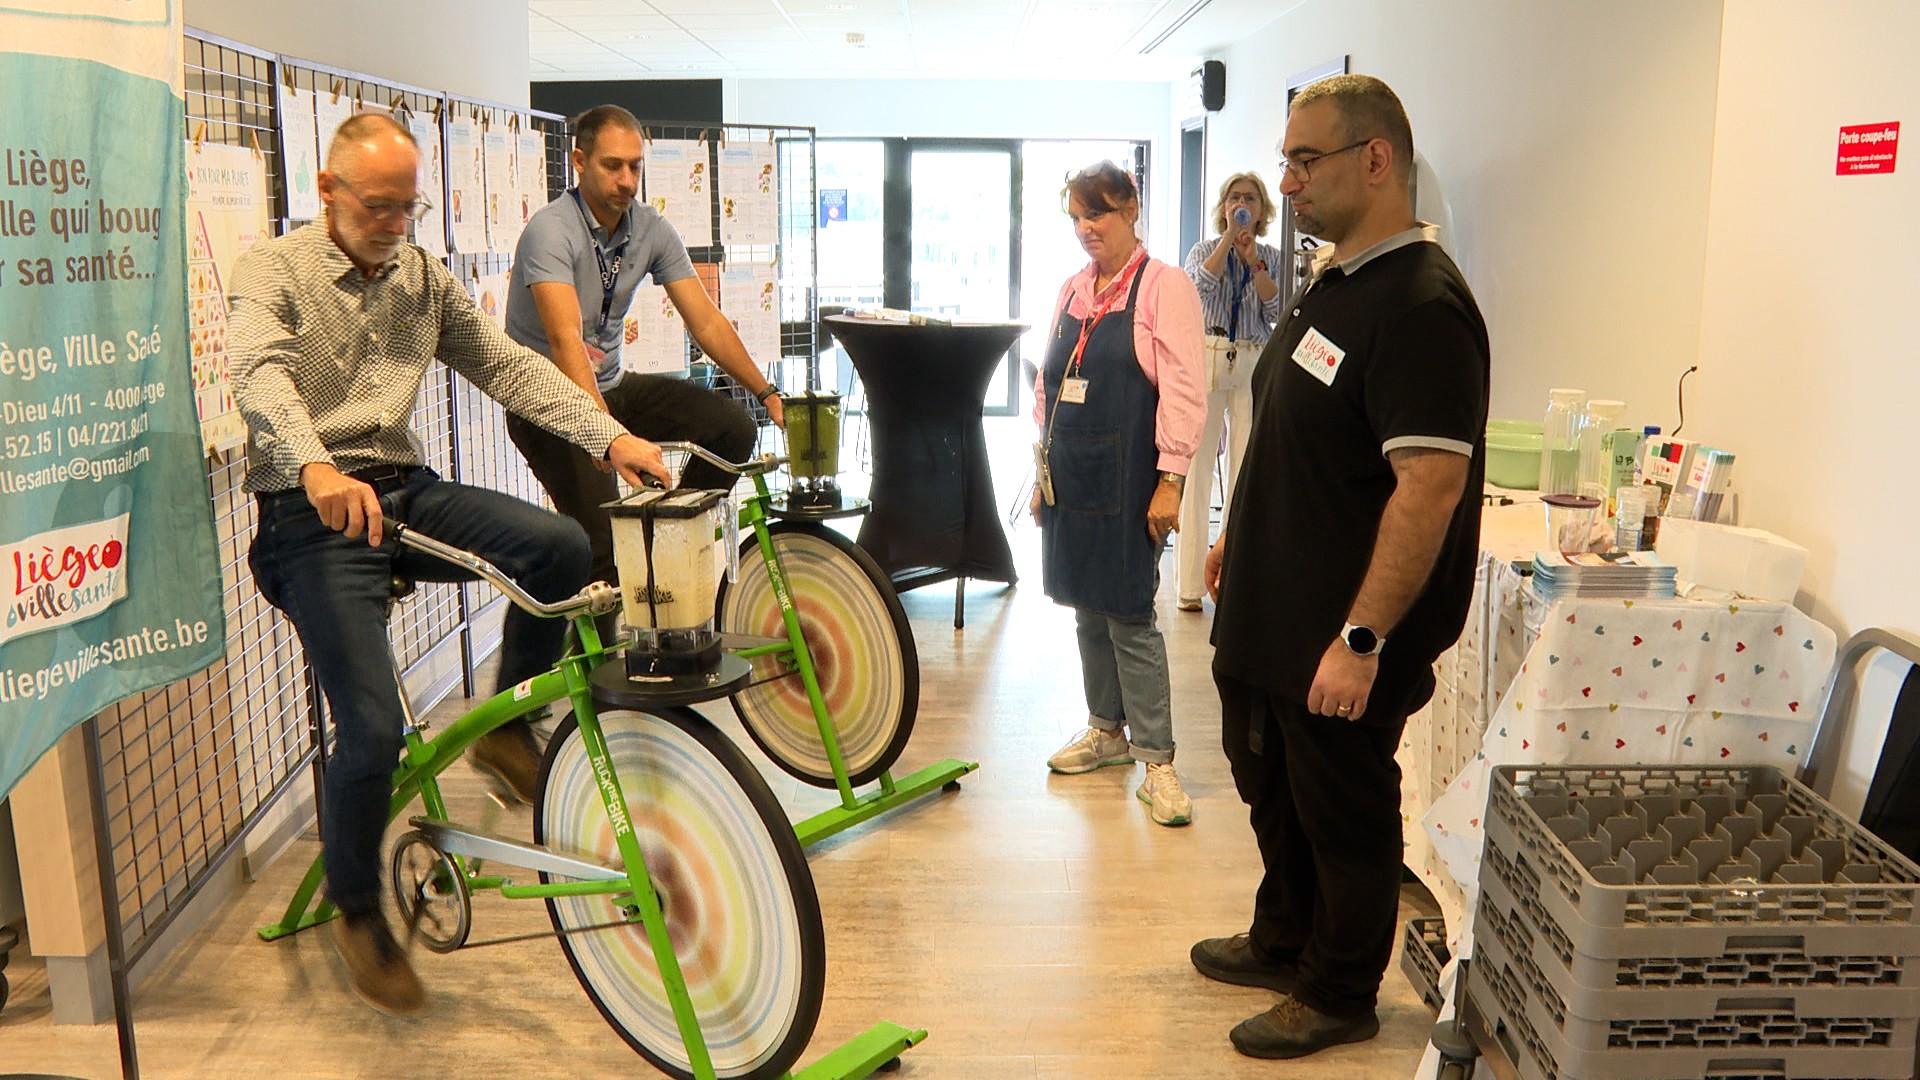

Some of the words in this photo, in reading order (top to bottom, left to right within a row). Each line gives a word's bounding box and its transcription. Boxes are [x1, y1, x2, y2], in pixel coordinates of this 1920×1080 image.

[1840, 132, 1859, 144] Porte
[1860, 128, 1897, 145] coupe-feu
[7, 149, 91, 194] Liège,
[50, 201, 90, 243] qui
[17, 257, 54, 286] sa
[66, 245, 156, 283] santé...
[64, 333, 116, 368] Ville
[52, 393, 82, 417] 4/11
[104, 386, 139, 411] 4000
[608, 802, 630, 837] BIKE
